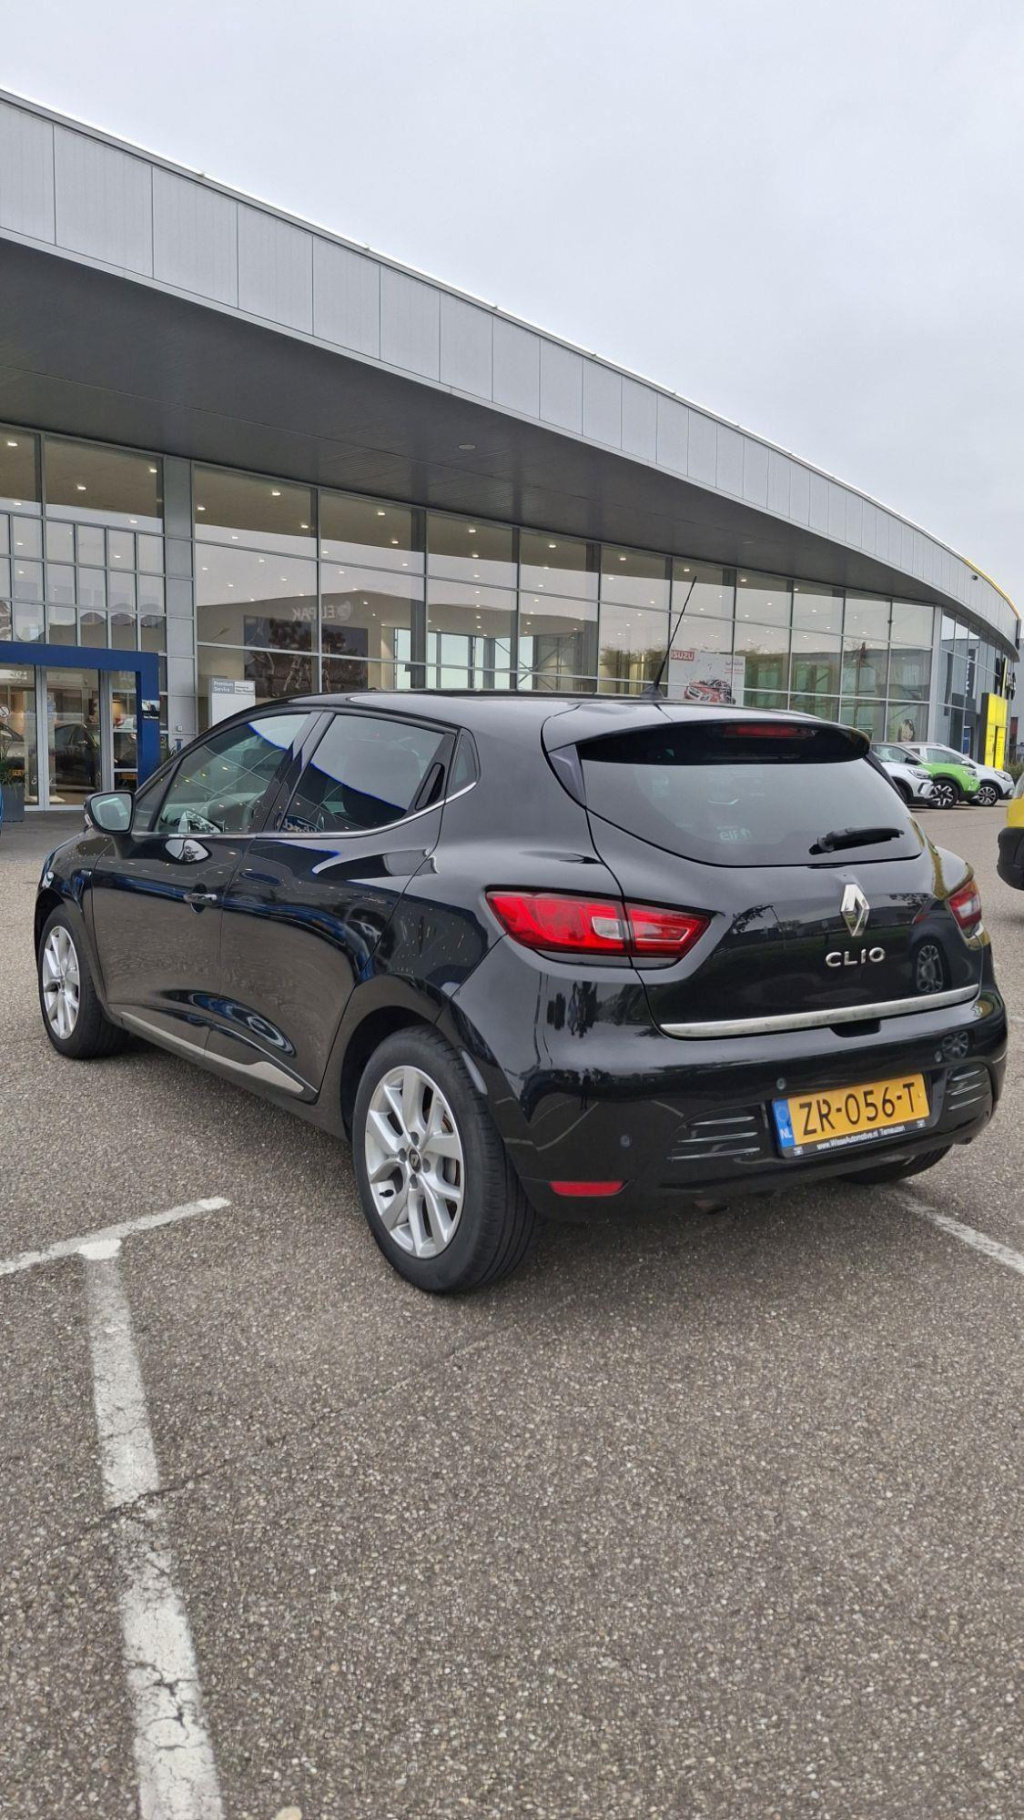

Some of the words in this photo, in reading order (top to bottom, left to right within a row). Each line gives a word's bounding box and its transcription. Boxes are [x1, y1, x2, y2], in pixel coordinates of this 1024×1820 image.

[670, 651, 694, 660] ISUZU
[719, 830, 739, 841] elf
[825, 946, 886, 967] CLIO
[799, 1082, 915, 1136] ZR-056-T
[780, 1128, 793, 1140] NL
